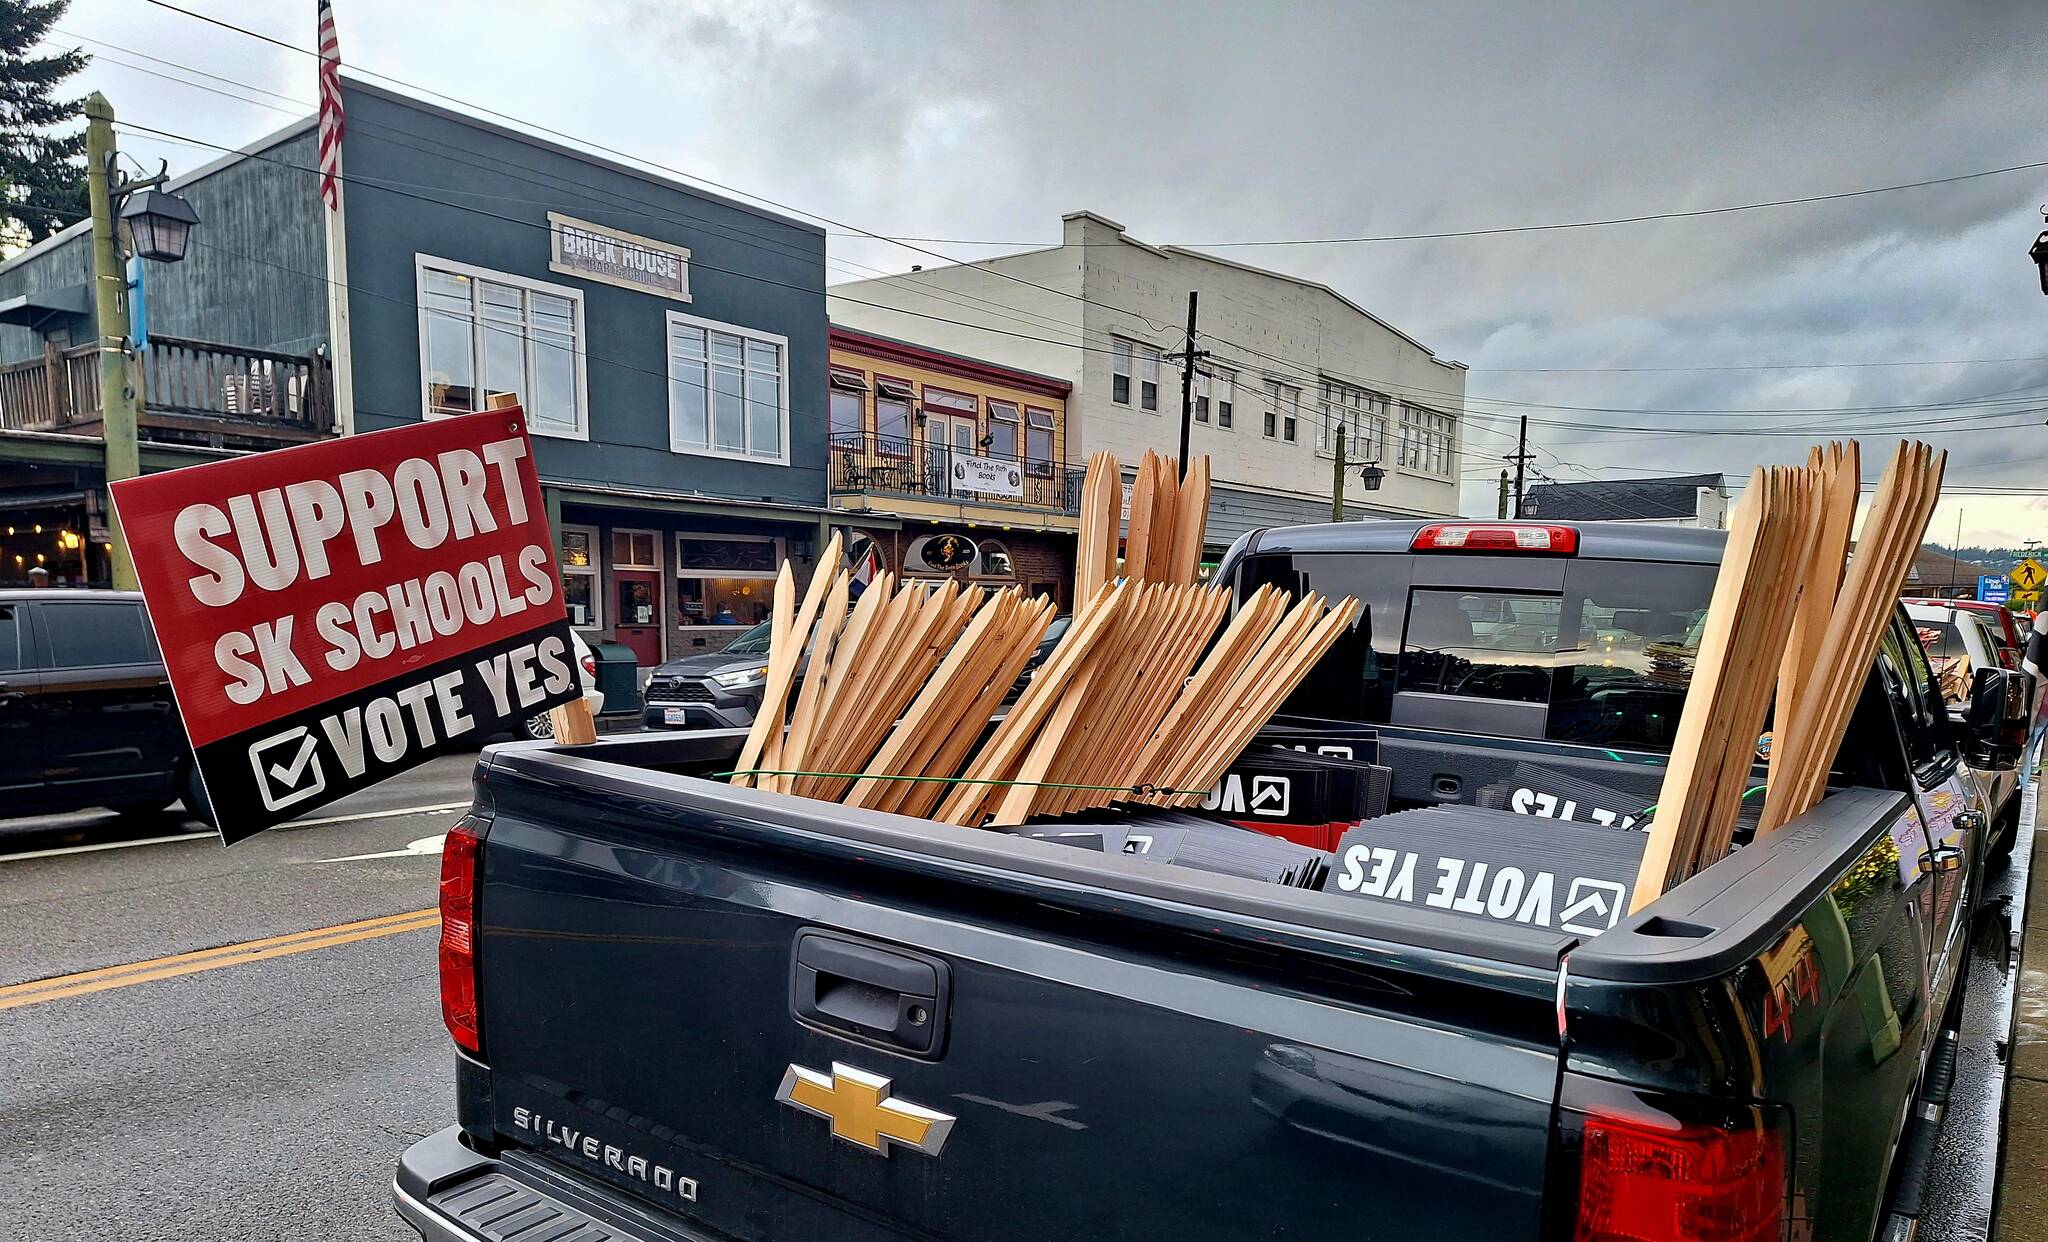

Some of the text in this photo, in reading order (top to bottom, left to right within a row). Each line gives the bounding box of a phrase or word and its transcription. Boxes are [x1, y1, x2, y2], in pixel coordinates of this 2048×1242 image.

[563, 226, 677, 280] BRICK HOUSE
[588, 259, 609, 274] BAR
[983, 462, 994, 471] The
[174, 437, 528, 607] SUPPORT
[214, 545, 553, 704] SK SCHOOLS
[320, 636, 571, 779] VOTE YES
[1337, 844, 1555, 927] VOTE YES
[514, 1107, 700, 1203] SILVERADO
